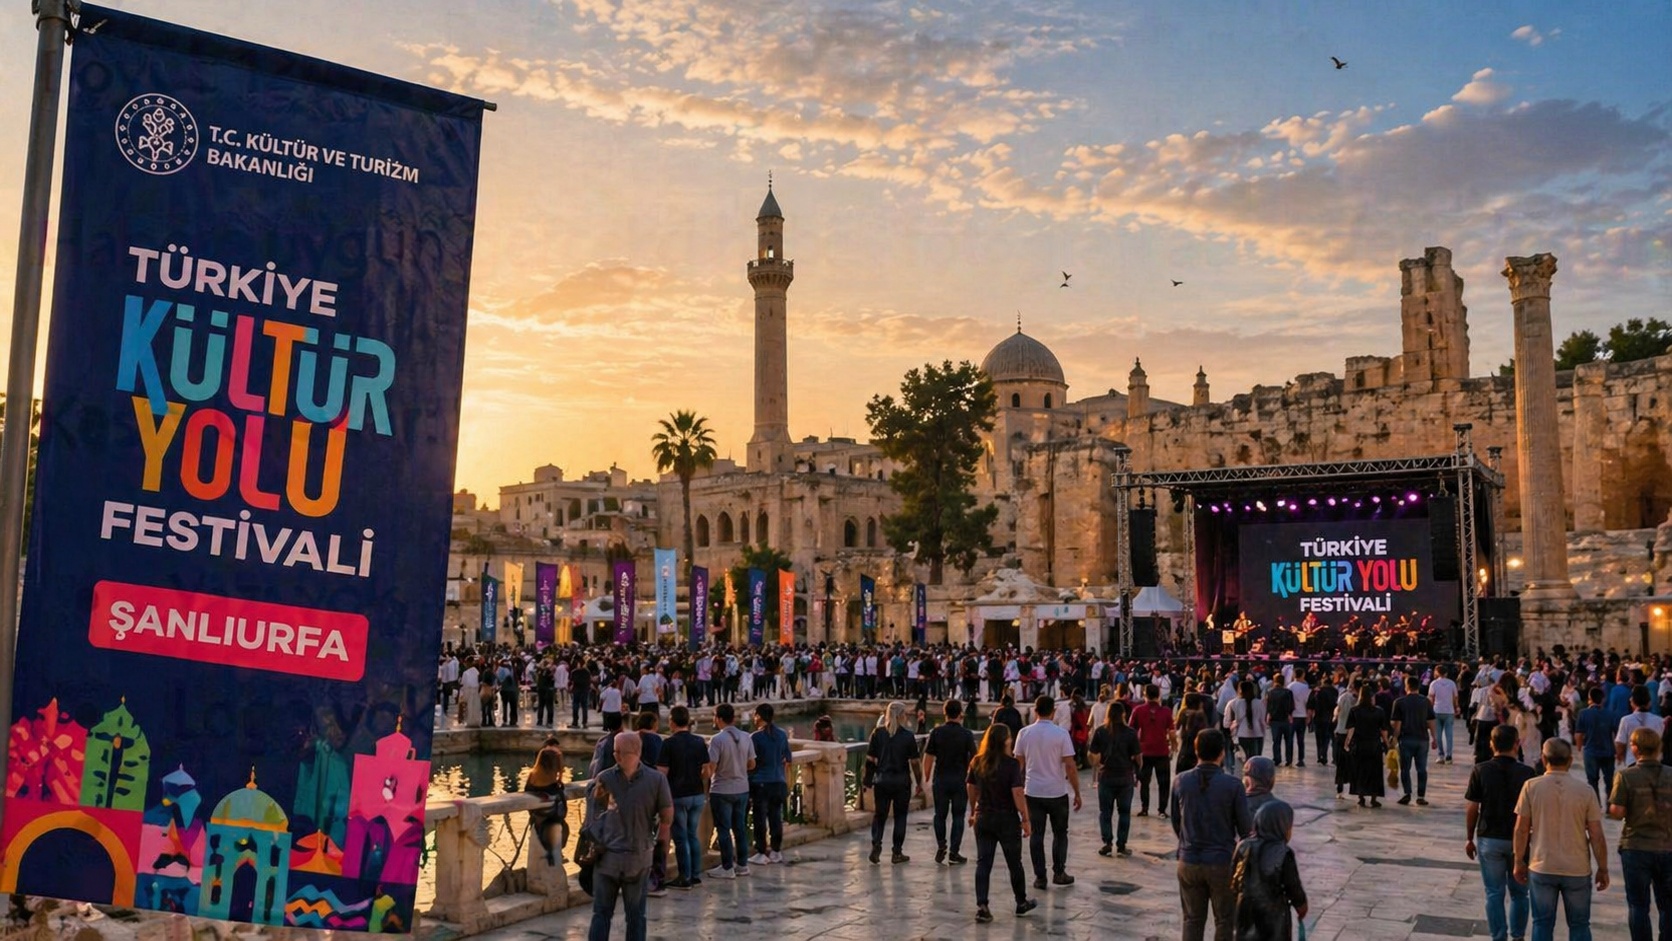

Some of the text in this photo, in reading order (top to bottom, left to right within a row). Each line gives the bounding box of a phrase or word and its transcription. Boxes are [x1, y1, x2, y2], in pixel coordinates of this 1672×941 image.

[206, 148, 314, 183] BAKANLIĞI
[209, 125, 241, 147] T.C.
[247, 132, 319, 162] KÜLTÜR
[322, 147, 346, 167] VE
[129, 243, 338, 317] TÜRKİYE
[116, 295, 396, 436] KÜLTÜR
[132, 396, 350, 517] YOLU
[100, 500, 375, 578] FESTİVALİ
[1300, 536, 1387, 558] TÜRKİYE
[1271, 559, 1418, 598] KÜLTÜR YOLU
[1300, 592, 1392, 612] FESTİVALİ
[108, 601, 349, 662] ŞANLIURFA
